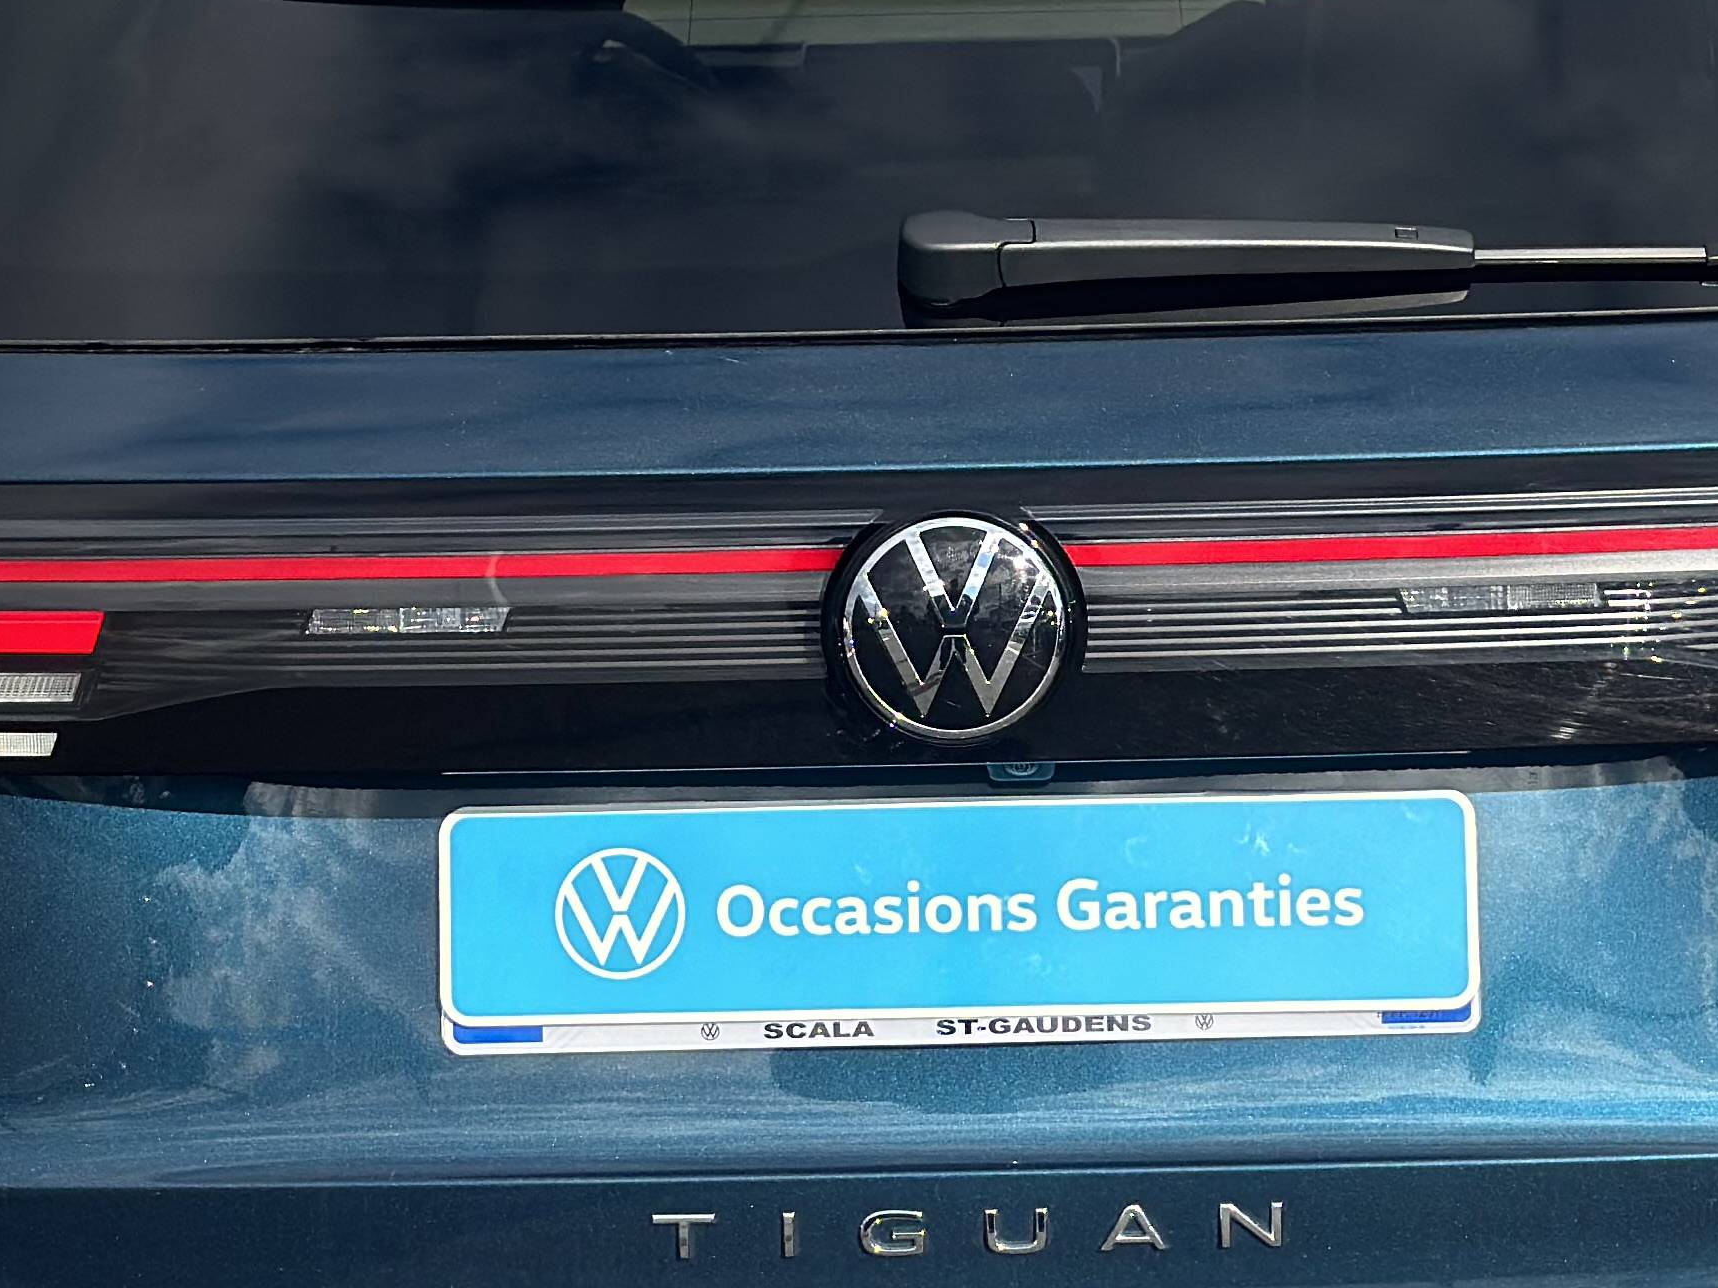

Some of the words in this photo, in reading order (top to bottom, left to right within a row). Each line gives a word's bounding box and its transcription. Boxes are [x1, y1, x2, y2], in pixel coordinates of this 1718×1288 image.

[716, 879, 1038, 938] Occasions
[1056, 872, 1364, 931] Garanties
[762, 1020, 876, 1040] SCALA
[935, 1014, 1154, 1037] ST-GAUDENS
[651, 1202, 1283, 1260] TIGUAN
